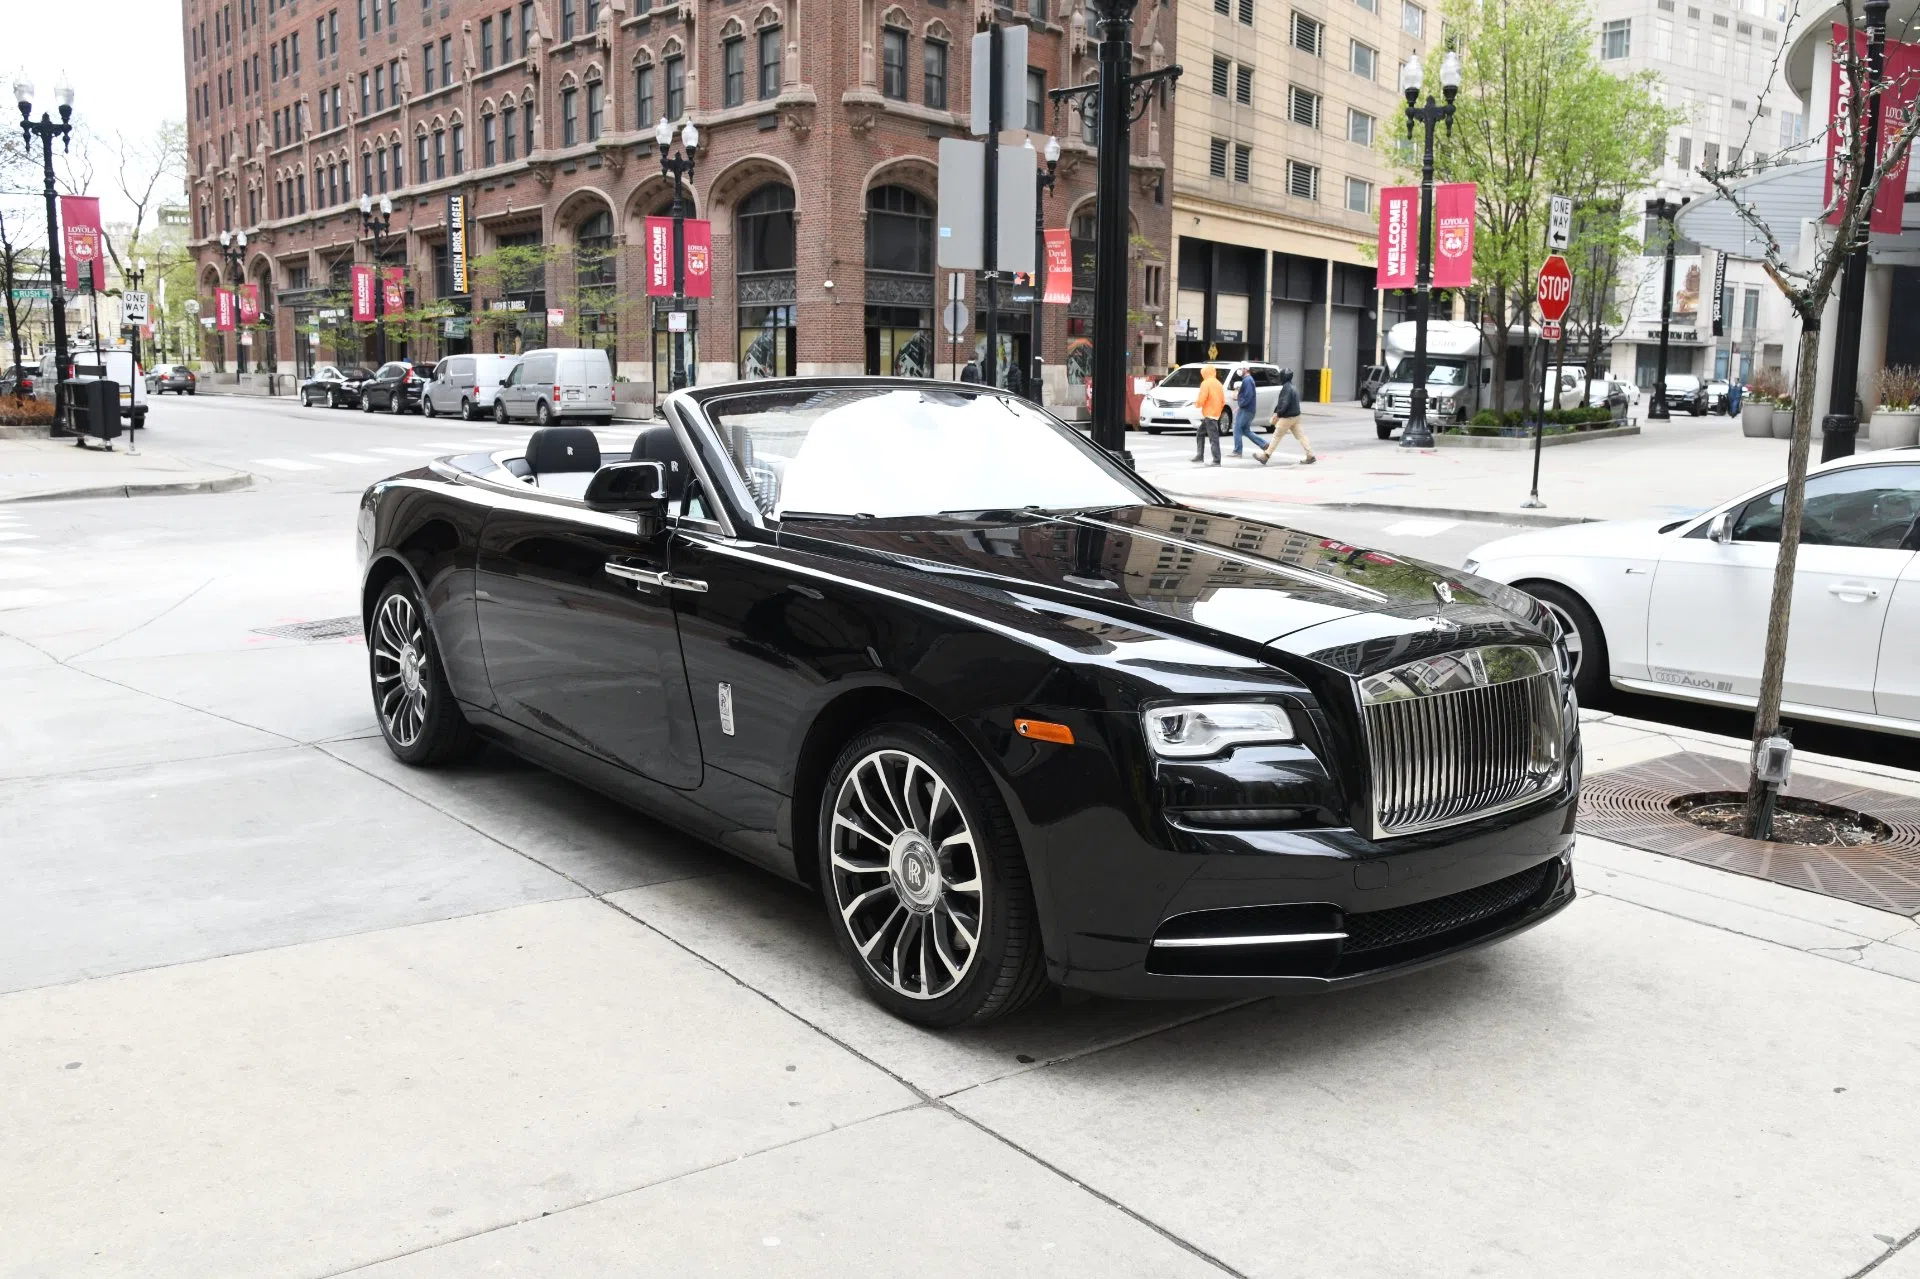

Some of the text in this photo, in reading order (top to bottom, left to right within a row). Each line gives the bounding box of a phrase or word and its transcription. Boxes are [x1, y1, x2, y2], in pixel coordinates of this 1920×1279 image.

[1554, 200, 1569, 215] ONE
[1440, 217, 1469, 225] LOYOLA
[1553, 215, 1569, 228] WAY
[451, 196, 464, 292] EINSTEIN BROS. BAGELS
[1387, 199, 1401, 277] WELCOME
[653, 226, 662, 286] WELCOME
[1539, 275, 1569, 301] STOP
[1713, 252, 1725, 321] ORDSTROM rack
[19, 290, 40, 298] RUSH
[126, 294, 145, 303] ONE
[357, 273, 366, 315] WELCOME
[126, 303, 145, 312] WAY
[1543, 327, 1551, 337] ALL
[1551, 327, 1559, 338] WAY
[1681, 676, 1715, 689] Audi
